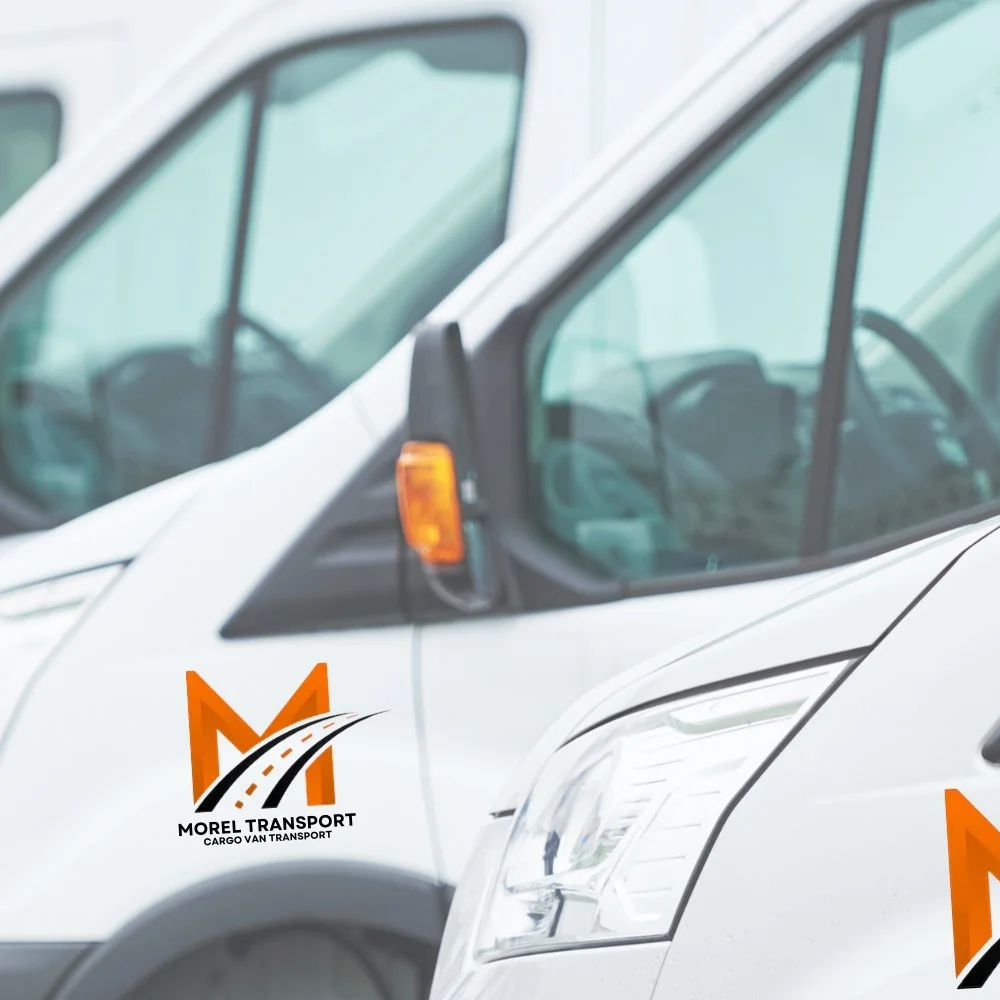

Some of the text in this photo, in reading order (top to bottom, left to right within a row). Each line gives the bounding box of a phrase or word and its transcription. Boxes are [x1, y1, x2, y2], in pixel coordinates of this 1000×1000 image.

[178, 812, 357, 837] MOREL TRANSPORT
[203, 830, 333, 846] CARGO VAN TRANSPORT
